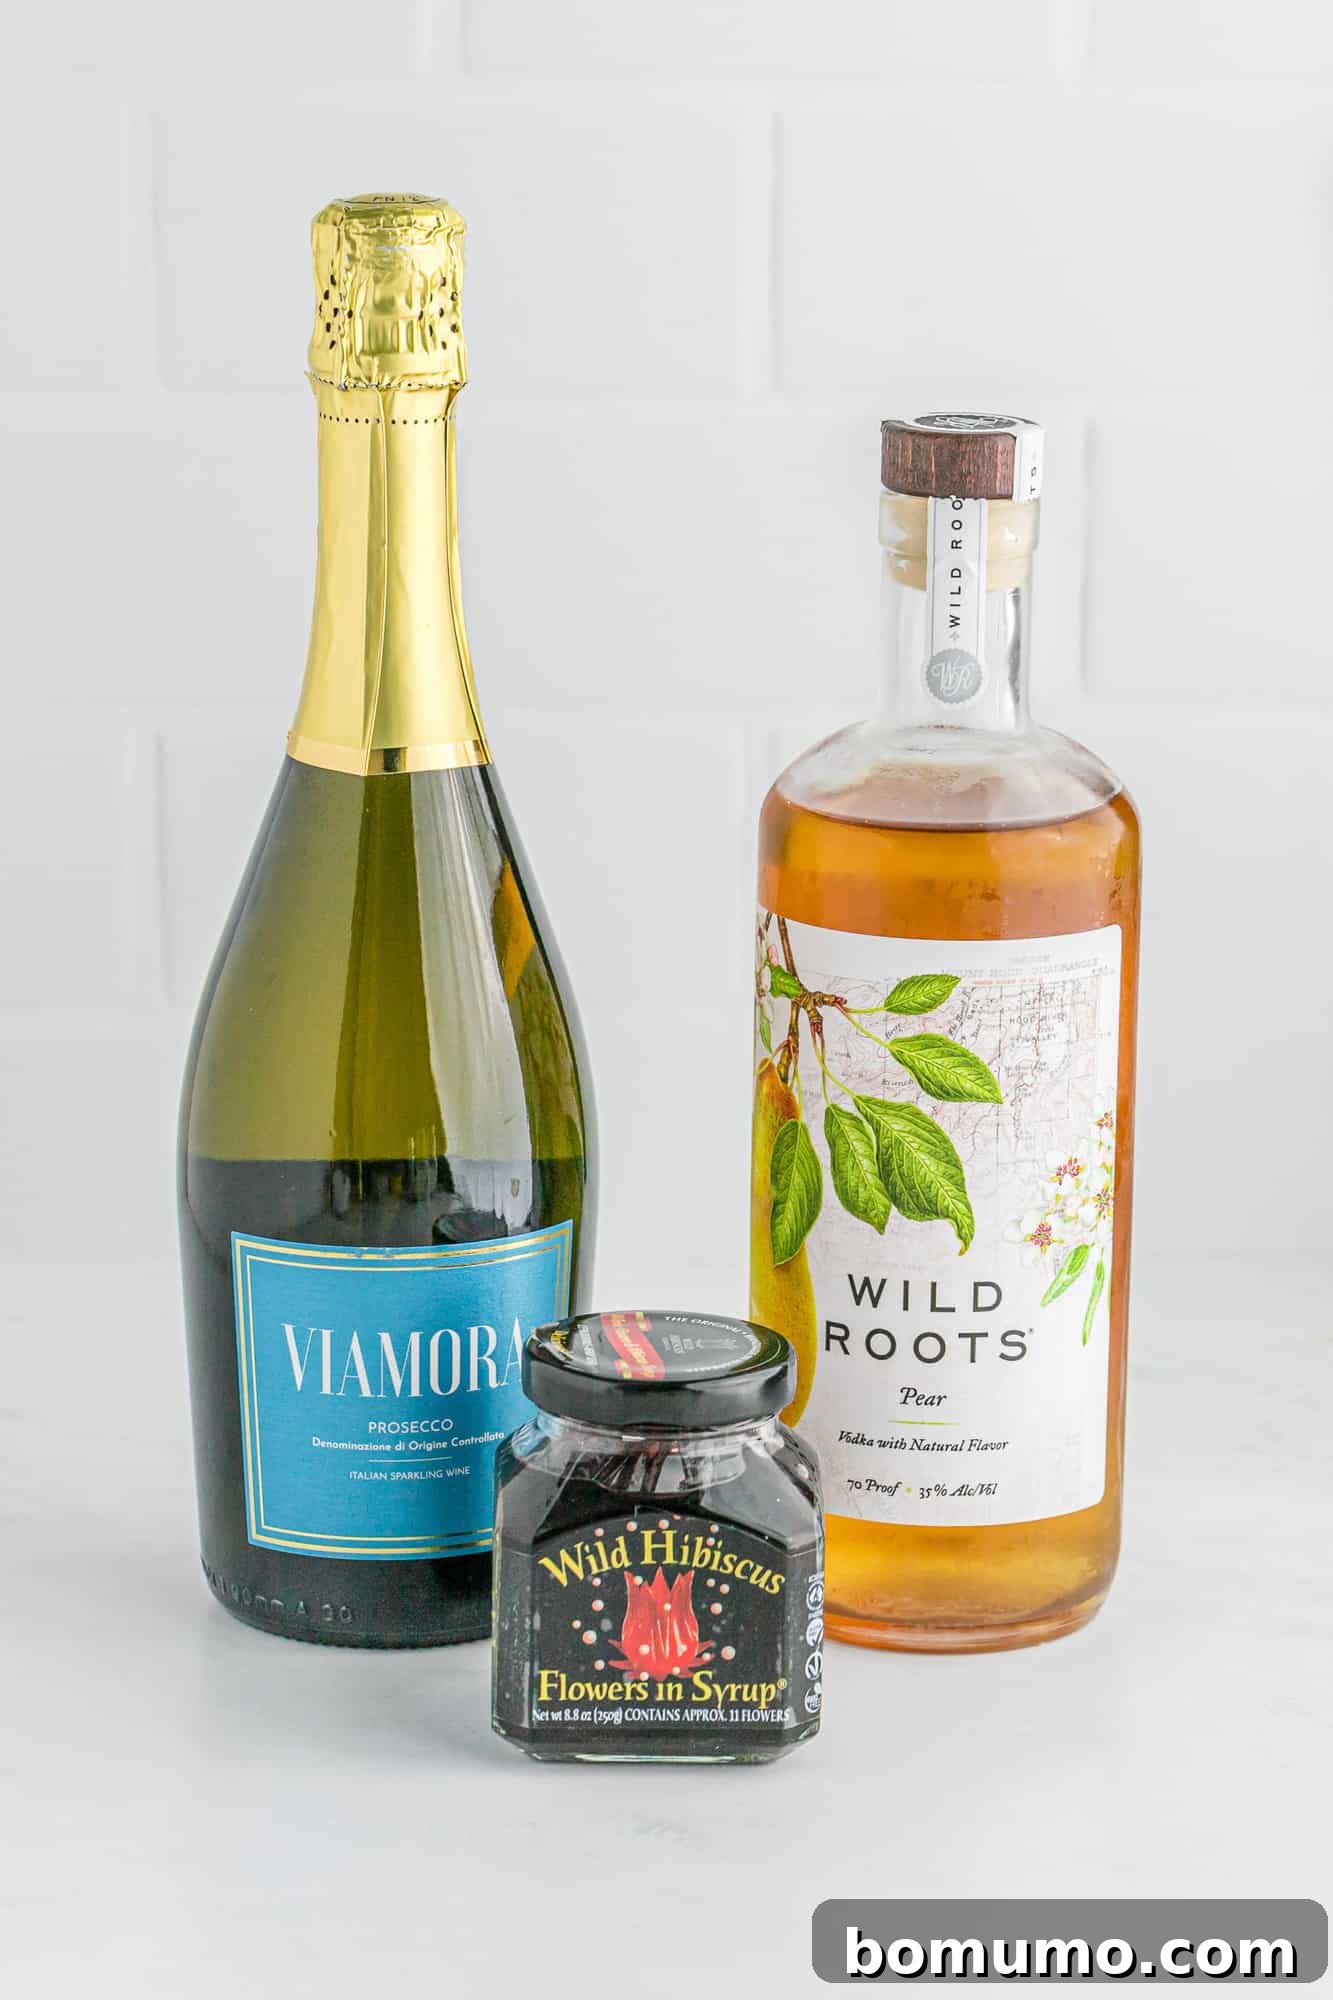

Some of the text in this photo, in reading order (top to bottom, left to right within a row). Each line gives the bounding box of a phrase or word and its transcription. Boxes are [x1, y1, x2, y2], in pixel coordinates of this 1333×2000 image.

[949, 567, 962, 628] WILD
[847, 1273, 1002, 1313] WILD
[281, 1316, 524, 1399] VIAMORA
[899, 1385, 948, 1408] Pear
[368, 1418, 454, 1434] PROSECCO
[312, 1430, 506, 1453] Denominazione di Origine Controllata
[837, 1429, 1009, 1453] Vodka with Natural Flavor
[349, 1465, 471, 1481] ITALIAN SPARKLING WINE
[846, 1478, 863, 1492] 70
[864, 1478, 903, 1498] Proof
[949, 1481, 999, 1498] Alc/Vol
[538, 1529, 786, 1595] Wild Hibiscus
[537, 1669, 649, 1701] Flowers
[656, 1678, 684, 1701] in
[532, 1708, 549, 1722] Net
[551, 1709, 562, 1721] wt
[564, 1708, 579, 1721] 8.8
[580, 1711, 592, 1721] oz
[593, 1707, 623, 1725] (250g)
[625, 1708, 681, 1722] CONTAINS
[741, 1709, 790, 1723] FLOWERS
